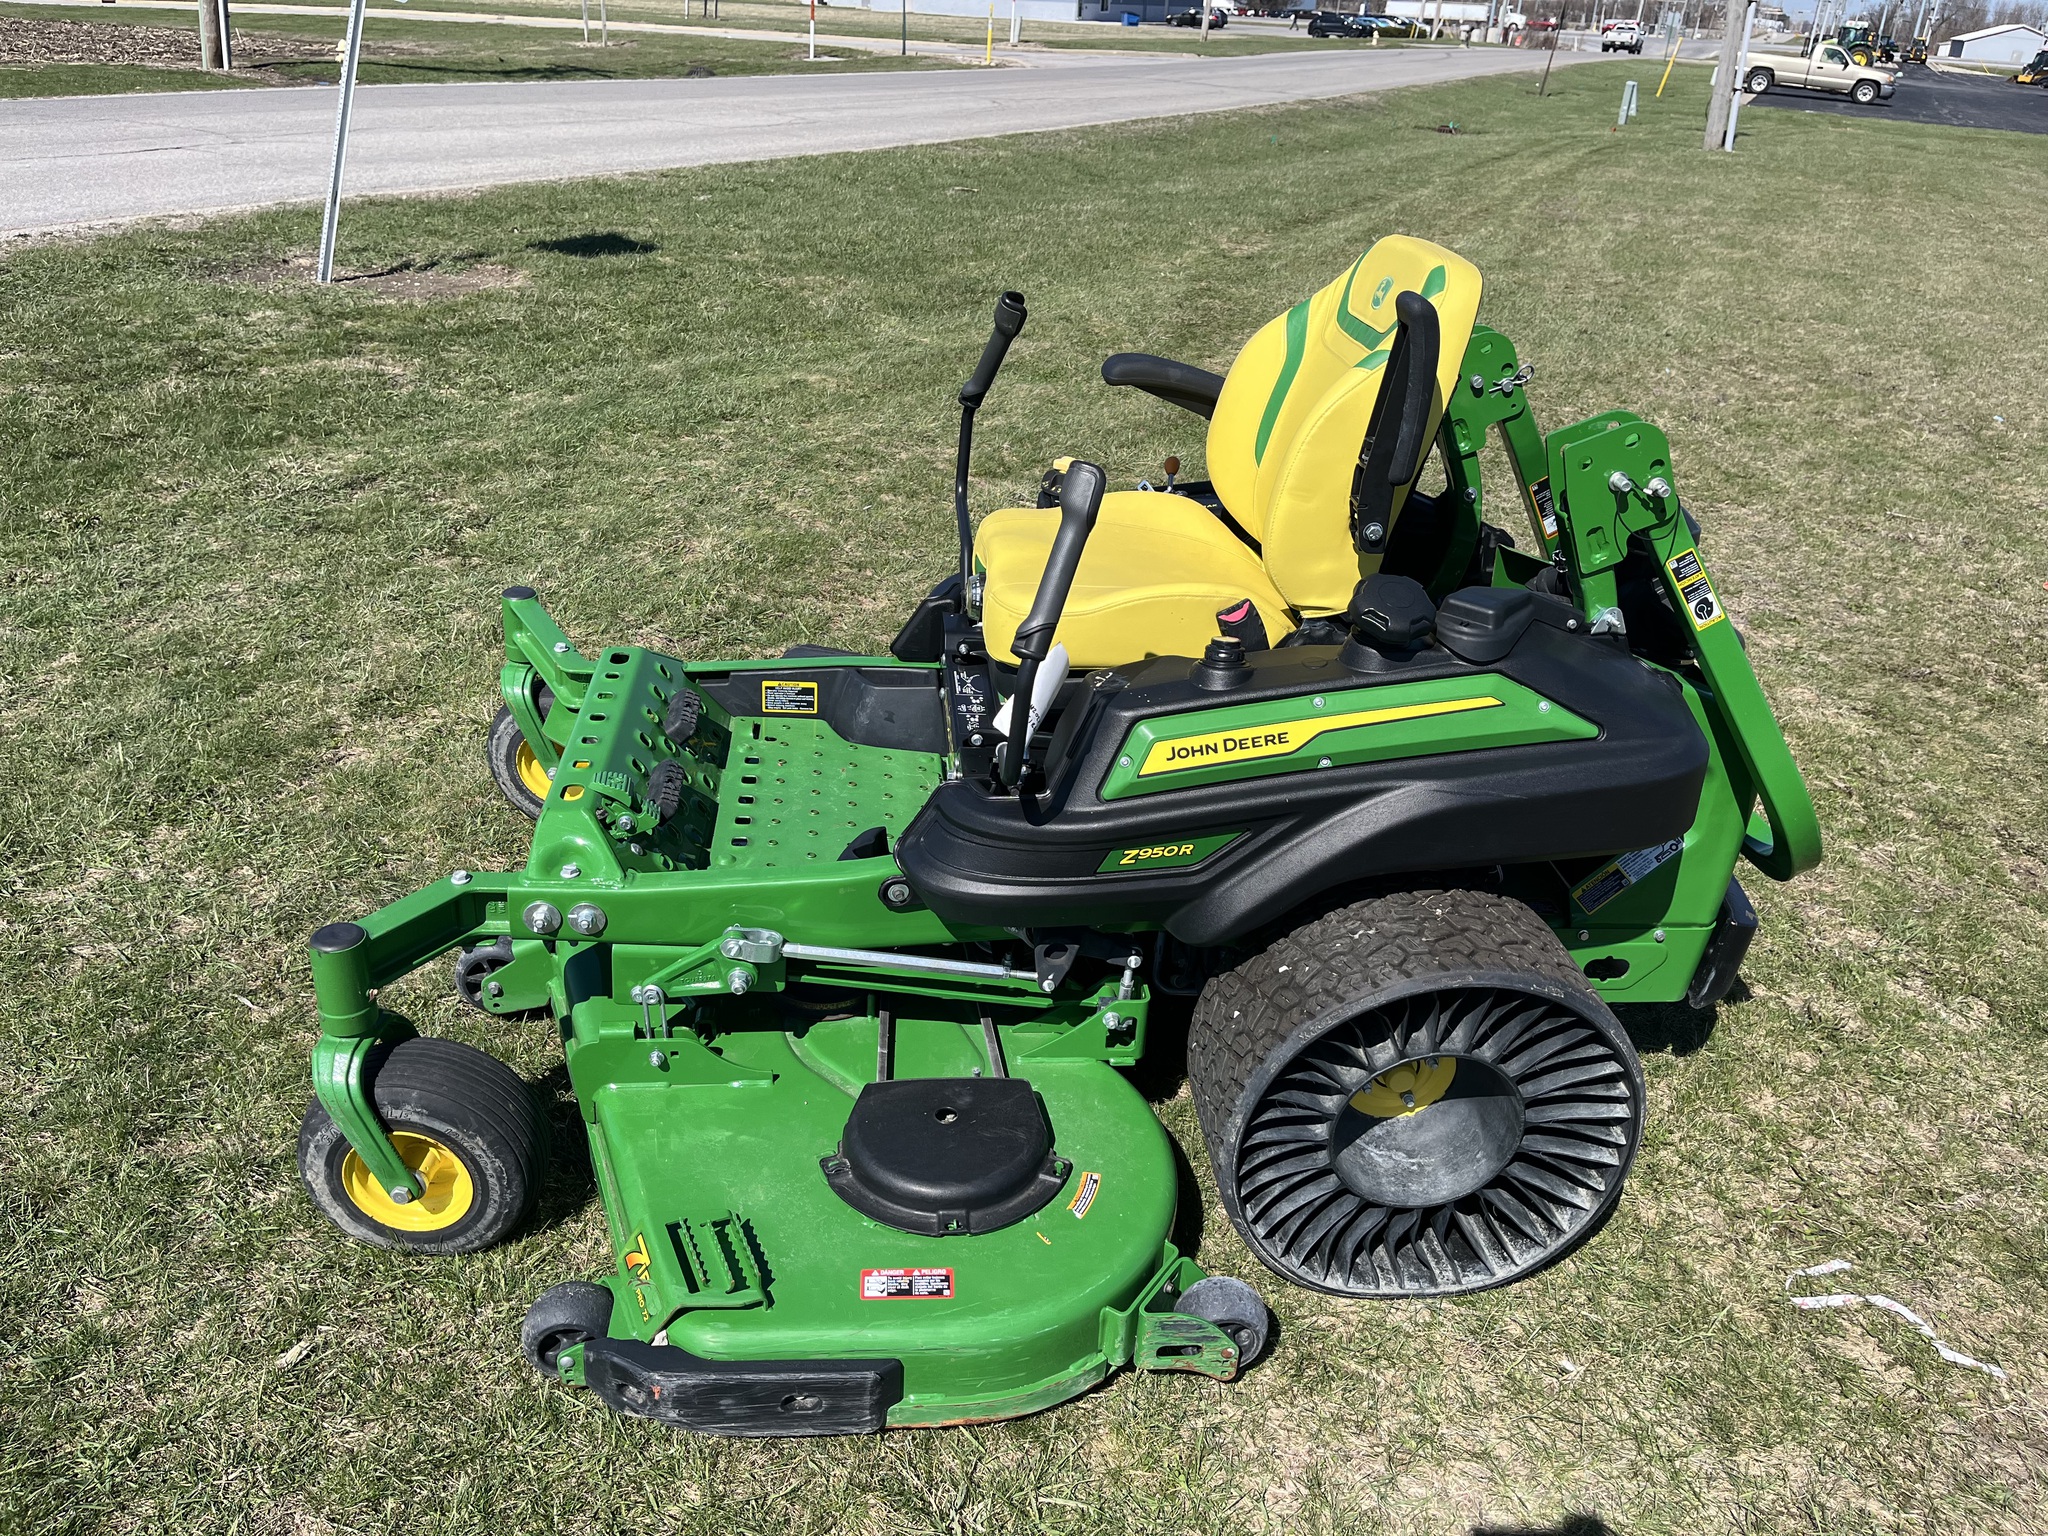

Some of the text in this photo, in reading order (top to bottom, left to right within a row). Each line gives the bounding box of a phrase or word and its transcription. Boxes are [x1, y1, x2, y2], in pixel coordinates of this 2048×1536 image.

[1166, 732, 1290, 761] JOHN DEERE
[635, 1287, 650, 1323] PRO 72
